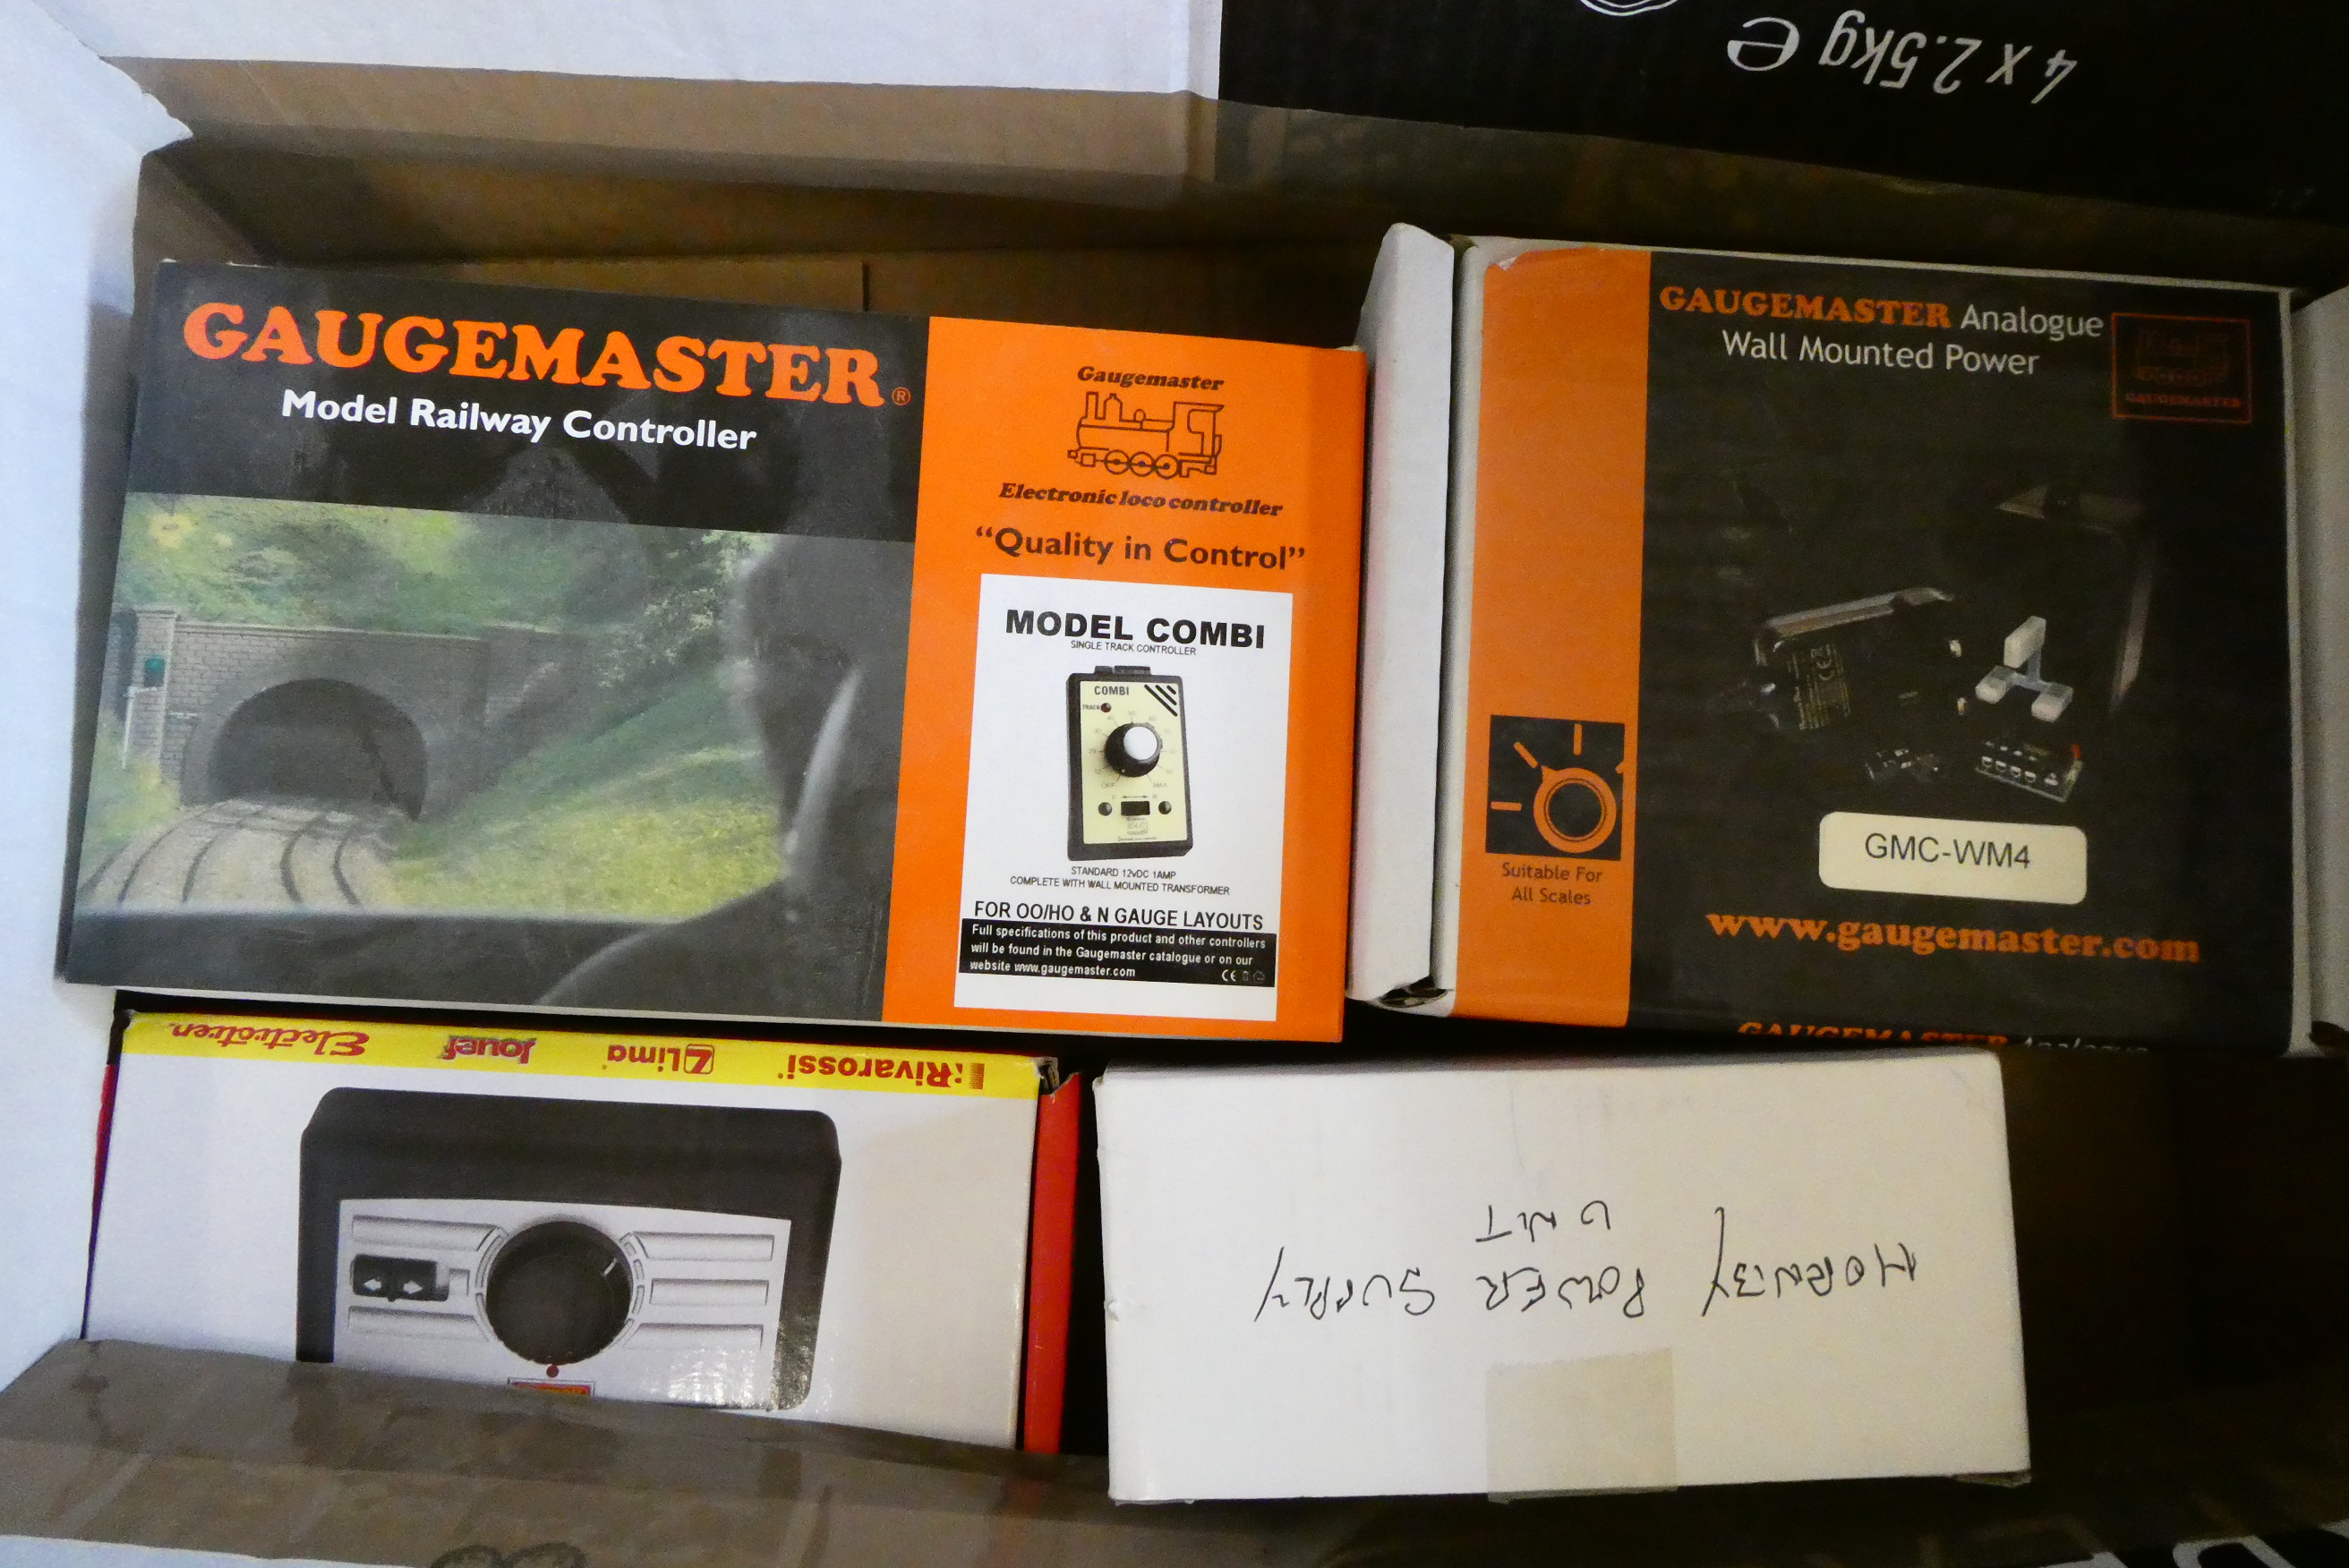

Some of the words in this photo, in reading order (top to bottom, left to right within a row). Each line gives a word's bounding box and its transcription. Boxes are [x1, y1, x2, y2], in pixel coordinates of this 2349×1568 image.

[1819, 9, 1980, 94] 2.5kg
[1986, 44, 2032, 85] x
[2032, 53, 2078, 104] 4
[1659, 285, 1952, 329] GAUGEMASTER
[1960, 303, 2106, 344] Analogue
[1721, 330, 1787, 362] Wall
[1800, 337, 1934, 370] Mounted
[1946, 344, 2040, 377] Power
[1077, 365, 1224, 391] Gaugemaster
[281, 388, 397, 426] Model
[411, 398, 551, 441] Railway
[563, 410, 756, 450] Controller
[998, 481, 1117, 506] Electronic
[1118, 490, 1166, 508] loco
[1169, 496, 1283, 516] controller
[1125, 535, 1151, 561] in
[1005, 609, 1133, 640] MODEL
[1147, 618, 1264, 649] COMBI
[1071, 640, 1102, 651] SINGLE
[1105, 642, 1134, 652] TRACK
[1136, 643, 1196, 656] CONTROLLER
[1094, 686, 1129, 695] COMBI
[1865, 831, 2032, 871] GMC-WM4
[1010, 875, 1060, 887] COMPLETE
[1063, 877, 1085, 888] WITH
[1088, 879, 1112, 890] WALL
[1114, 881, 1159, 891] MOUNTED
[1162, 882, 1230, 895] TRANSFORMER
[1071, 865, 1118, 877] STANDARD
[1153, 871, 1176, 880] 1AMP
[1502, 862, 1570, 881] Suitable
[1576, 866, 1602, 882] For
[1511, 887, 1533, 902] All
[1540, 888, 1592, 905] Scales
[974, 901, 1012, 919] FOR
[1080, 906, 1092, 922] &
[1098, 907, 1109, 923] N
[1115, 908, 1178, 926] GAUGE
[1183, 911, 1263, 931] LAYOUTS
[972, 924, 993, 936] Full
[995, 925, 1071, 941] specifications
[1074, 929, 1086, 941] of
[1087, 929, 1106, 942] this
[1110, 932, 1153, 947] product
[1155, 933, 1175, 946] and
[1178, 934, 1206, 947] other
[1209, 936, 1266, 950] controllers
[1706, 912, 2202, 963] www.gaugemaster.com
[970, 959, 1011, 972] website
[1014, 961, 1136, 978] www.gaugemaster.com
[971, 942, 989, 954] will
[992, 943, 1005, 955] be
[1009, 944, 1039, 957] found
[1043, 946, 1053, 957] in
[1055, 947, 1072, 958] the
[1076, 947, 1146, 962] Gaugemaster
[1149, 950, 1201, 966] catalogue
[1204, 956, 1216, 964] or
[1219, 955, 1233, 965] on
[1235, 956, 1253, 966] our
[173, 1022, 369, 1056] Electrotren
[437, 1035, 536, 1065] Jouef
[607, 1044, 680, 1073] Lima
[787, 1054, 964, 1087] Rivarossi
[1701, 1206, 1917, 1317] HORNBY
[1253, 1247, 1435, 1323] SUPPLY
[1475, 1266, 1645, 1319] POWER
